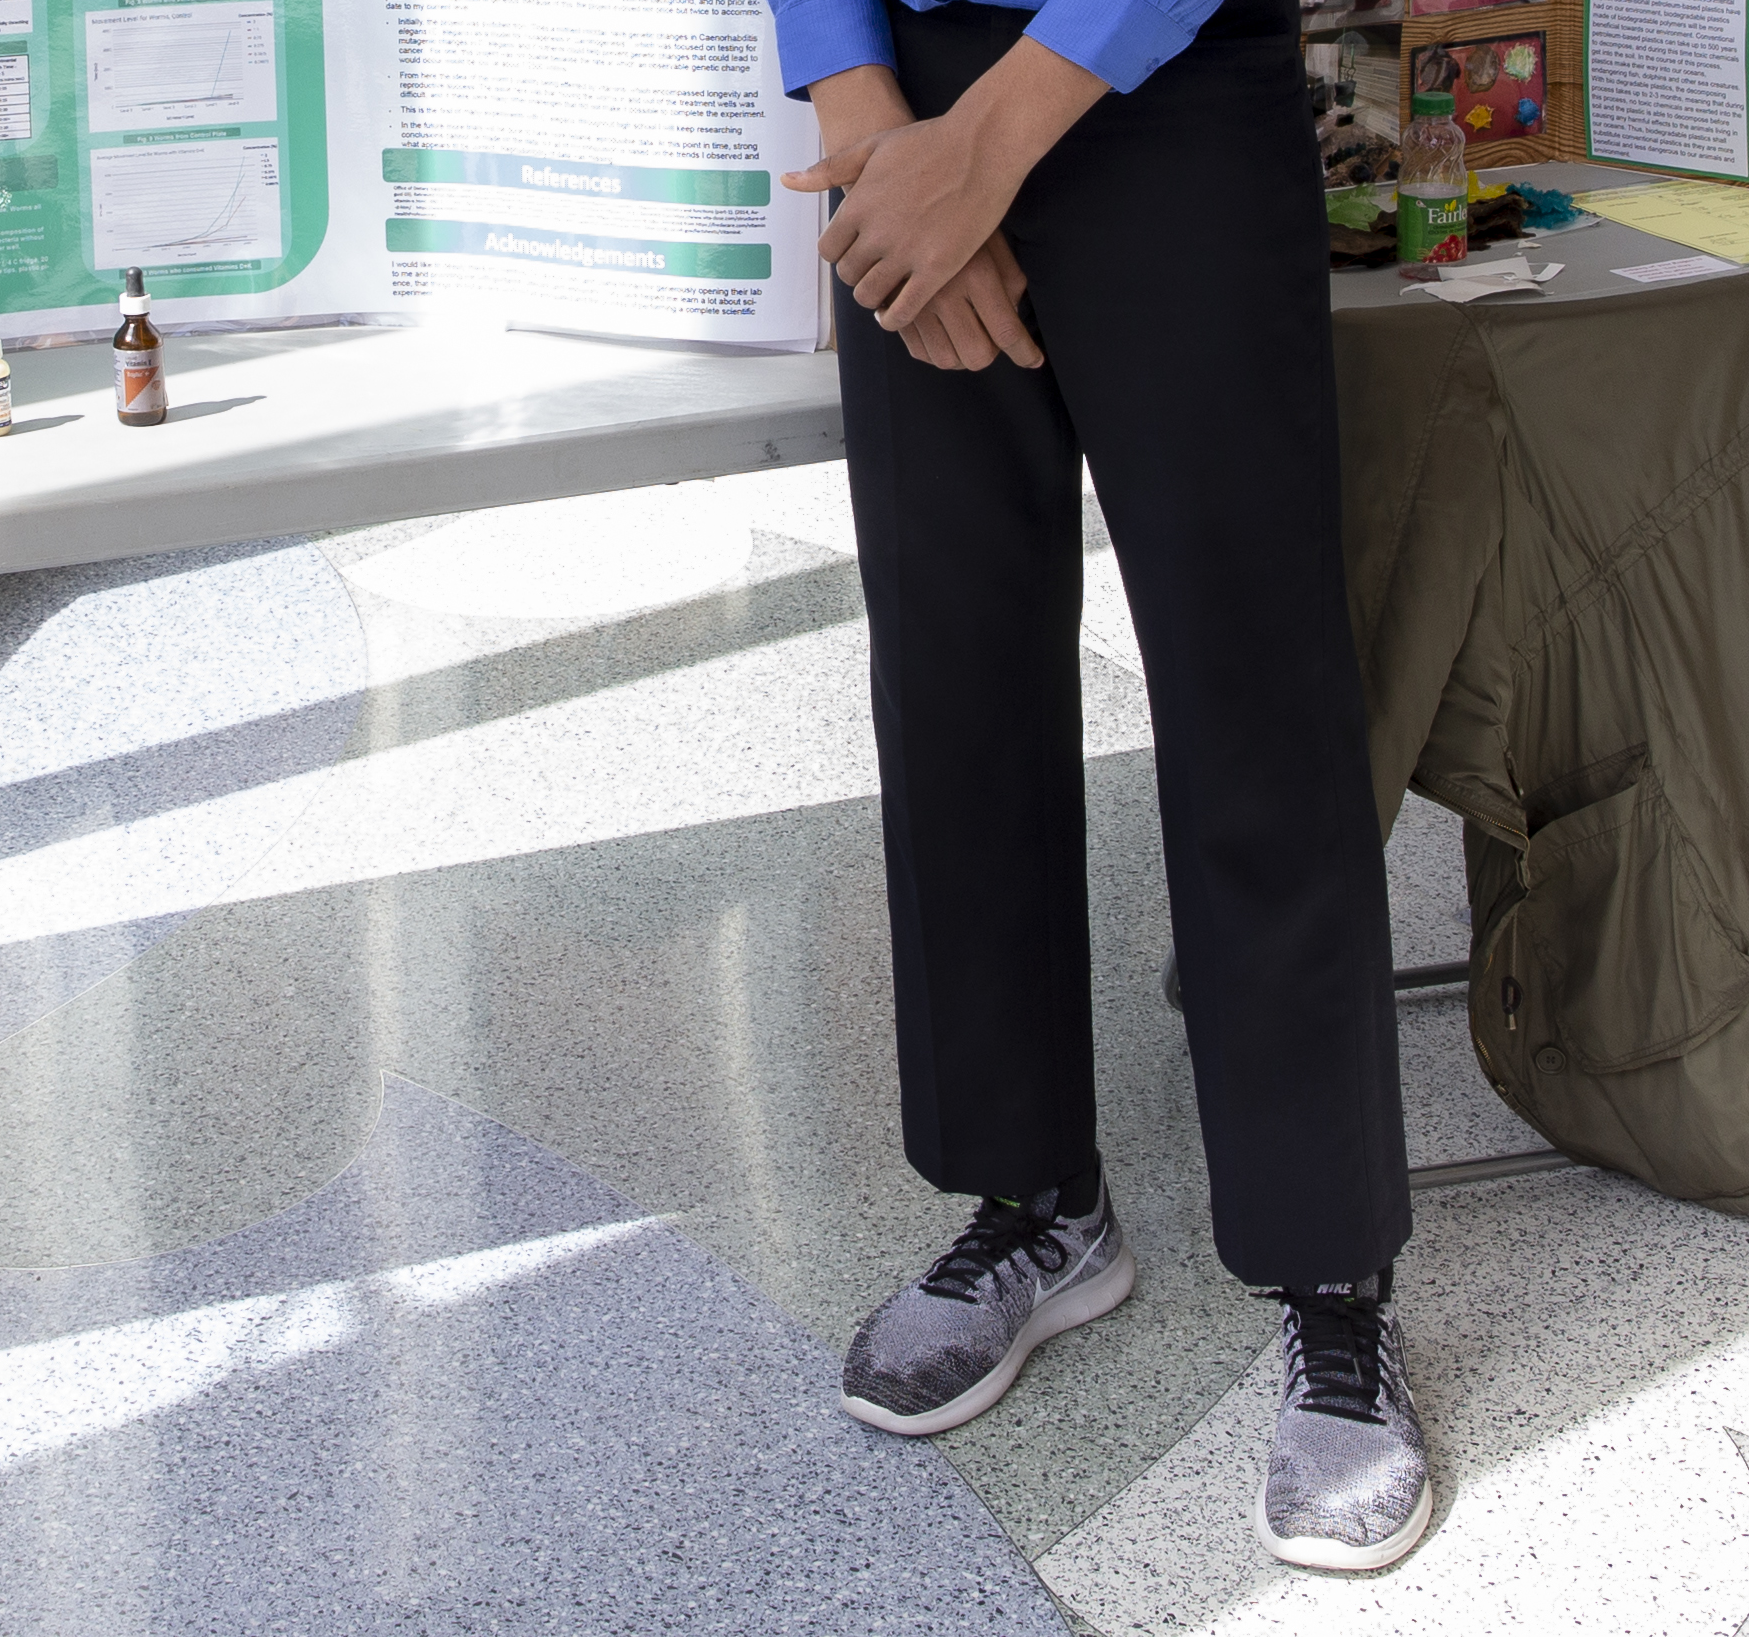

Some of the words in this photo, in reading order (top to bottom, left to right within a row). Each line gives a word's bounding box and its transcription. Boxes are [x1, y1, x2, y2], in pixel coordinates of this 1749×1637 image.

[521, 165, 622, 193] References
[485, 233, 665, 269] Acknowledgements
[1316, 1283, 1352, 1294] NIKE
